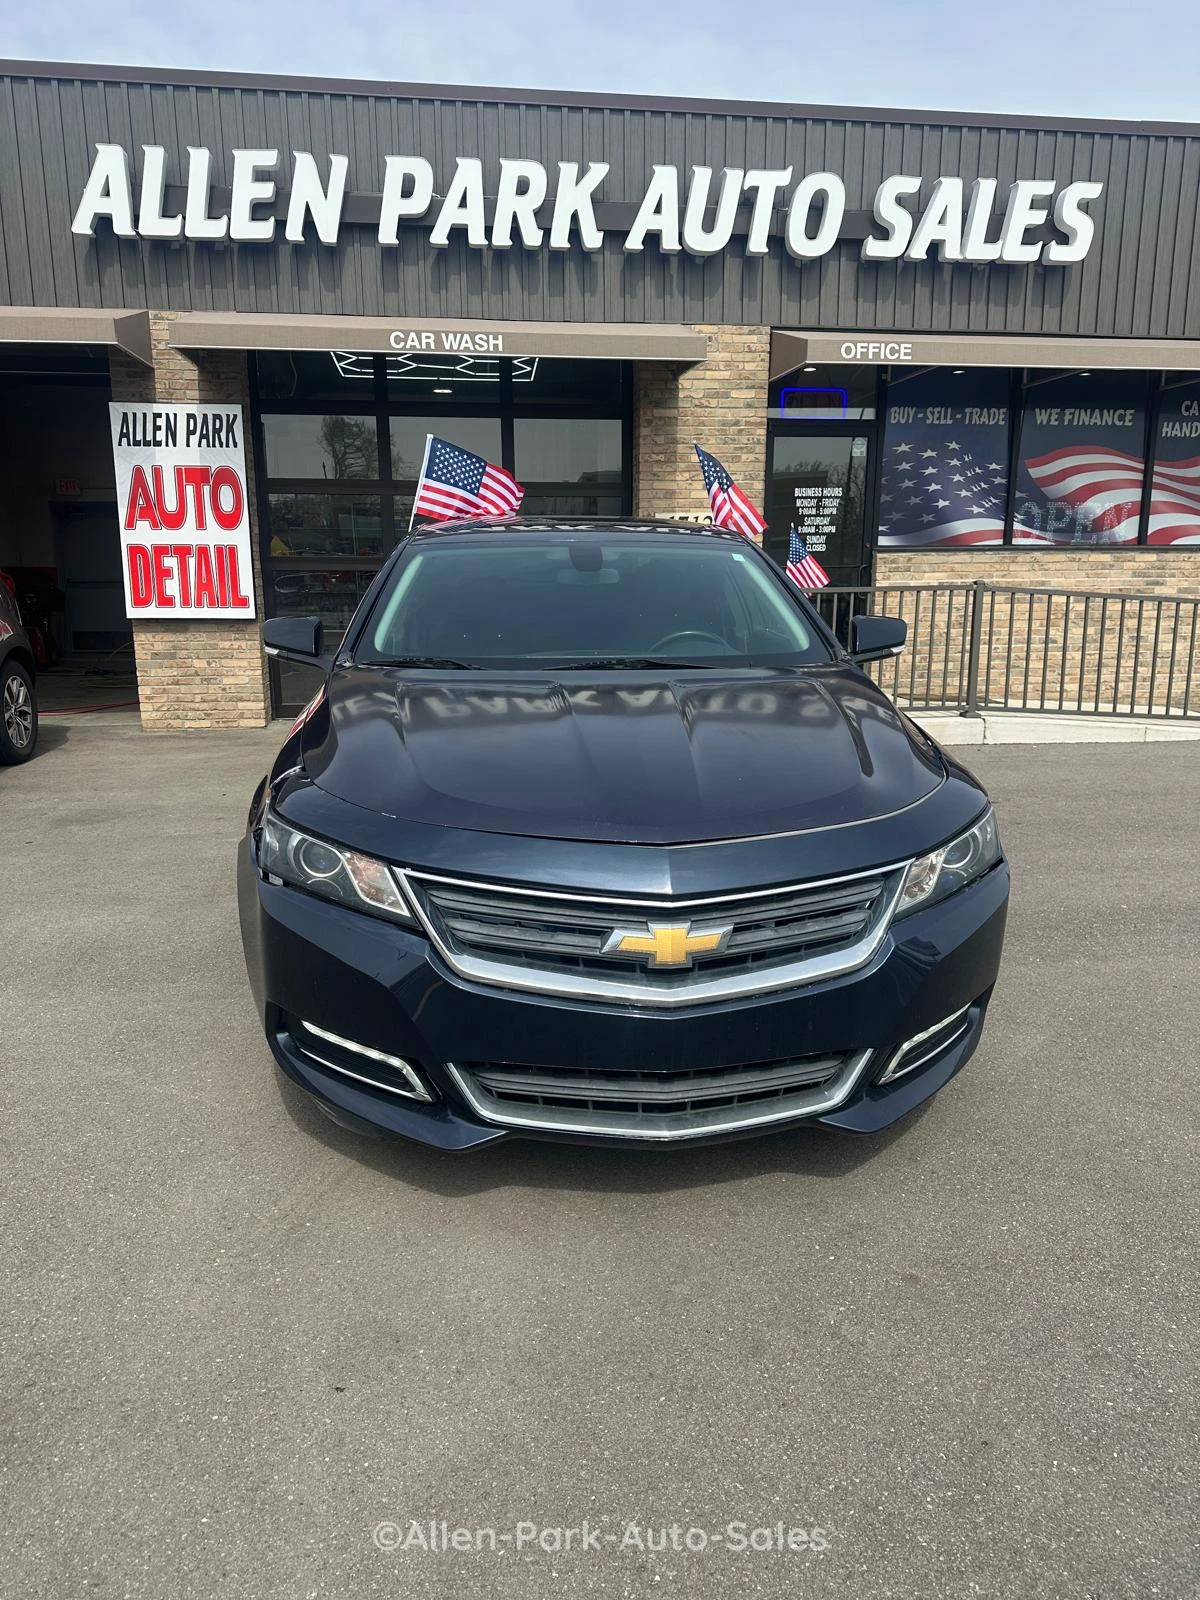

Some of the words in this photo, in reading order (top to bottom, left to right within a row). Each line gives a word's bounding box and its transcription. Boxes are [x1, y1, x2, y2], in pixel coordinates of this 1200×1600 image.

[71, 143, 348, 245] ALLEN
[378, 155, 610, 251] PARK
[623, 164, 846, 259] AUTO
[861, 175, 1104, 265] SALES
[389, 331, 435, 350] CAR
[441, 332, 503, 352] WASH
[840, 342, 912, 360] OFFICE
[890, 406, 916, 424] BUY
[926, 406, 953, 425] SELL
[964, 407, 1008, 425] TRADE
[1035, 407, 1061, 425] WE
[1063, 408, 1136, 426] FINANCE
[118, 411, 178, 448] ALLEN
[186, 412, 238, 448] PARK
[124, 464, 244, 531] AUTO
[795, 488, 822, 496] BUSINESS
[823, 488, 842, 496] HOURS
[796, 498, 817, 507] MONDAY
[821, 498, 840, 507] FRIDAY
[798, 507, 817, 515] 9:00AM
[819, 507, 837, 515] 5:00PM
[797, 525, 816, 533] 9:00AM
[818, 525, 836, 533] 3:00PM
[804, 517, 830, 525] SATURDAY
[806, 535, 826, 543] SUNDAY
[126, 543, 250, 609] DETAIL
